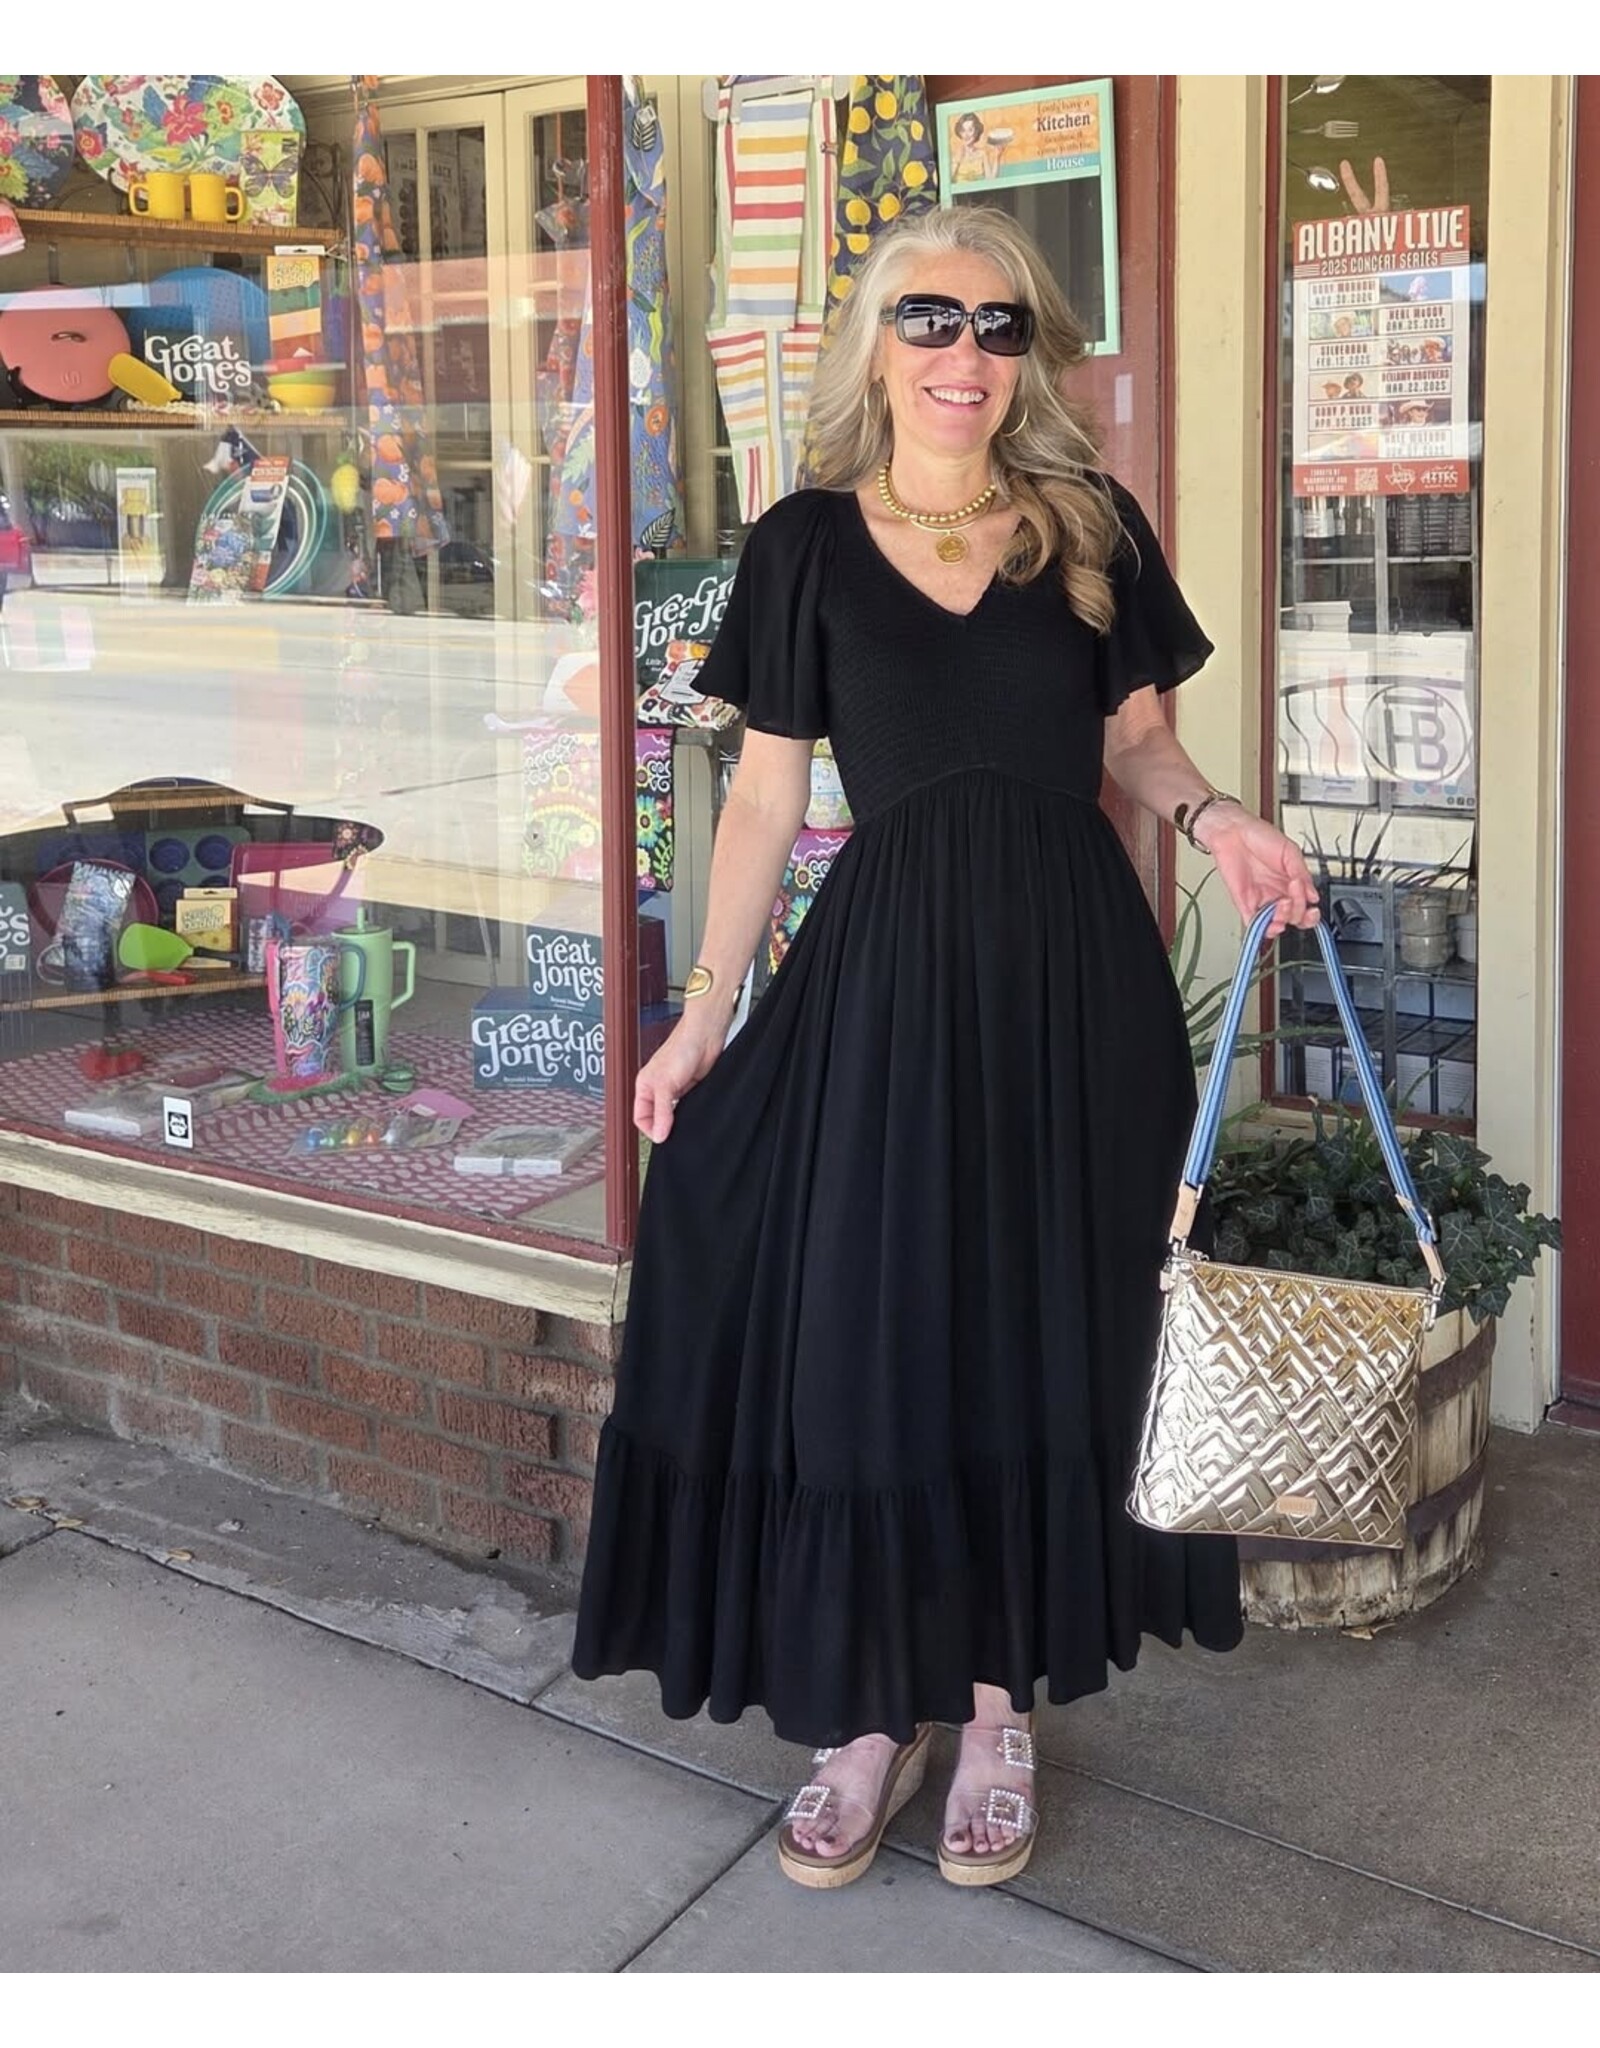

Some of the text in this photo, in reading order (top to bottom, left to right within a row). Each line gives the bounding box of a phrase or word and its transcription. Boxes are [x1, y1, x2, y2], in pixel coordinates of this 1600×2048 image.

[1037, 113, 1091, 132] Kitchen
[1046, 157, 1085, 171] House
[1298, 209, 1464, 262] ALBANY LIVE
[1320, 250, 1438, 276] 2025 CONCERT SERIES
[144, 334, 239, 364] Great
[162, 359, 252, 393] Jones
[635, 593, 693, 631] Grea
[527, 933, 597, 965] Great
[471, 1013, 569, 1047] Great
